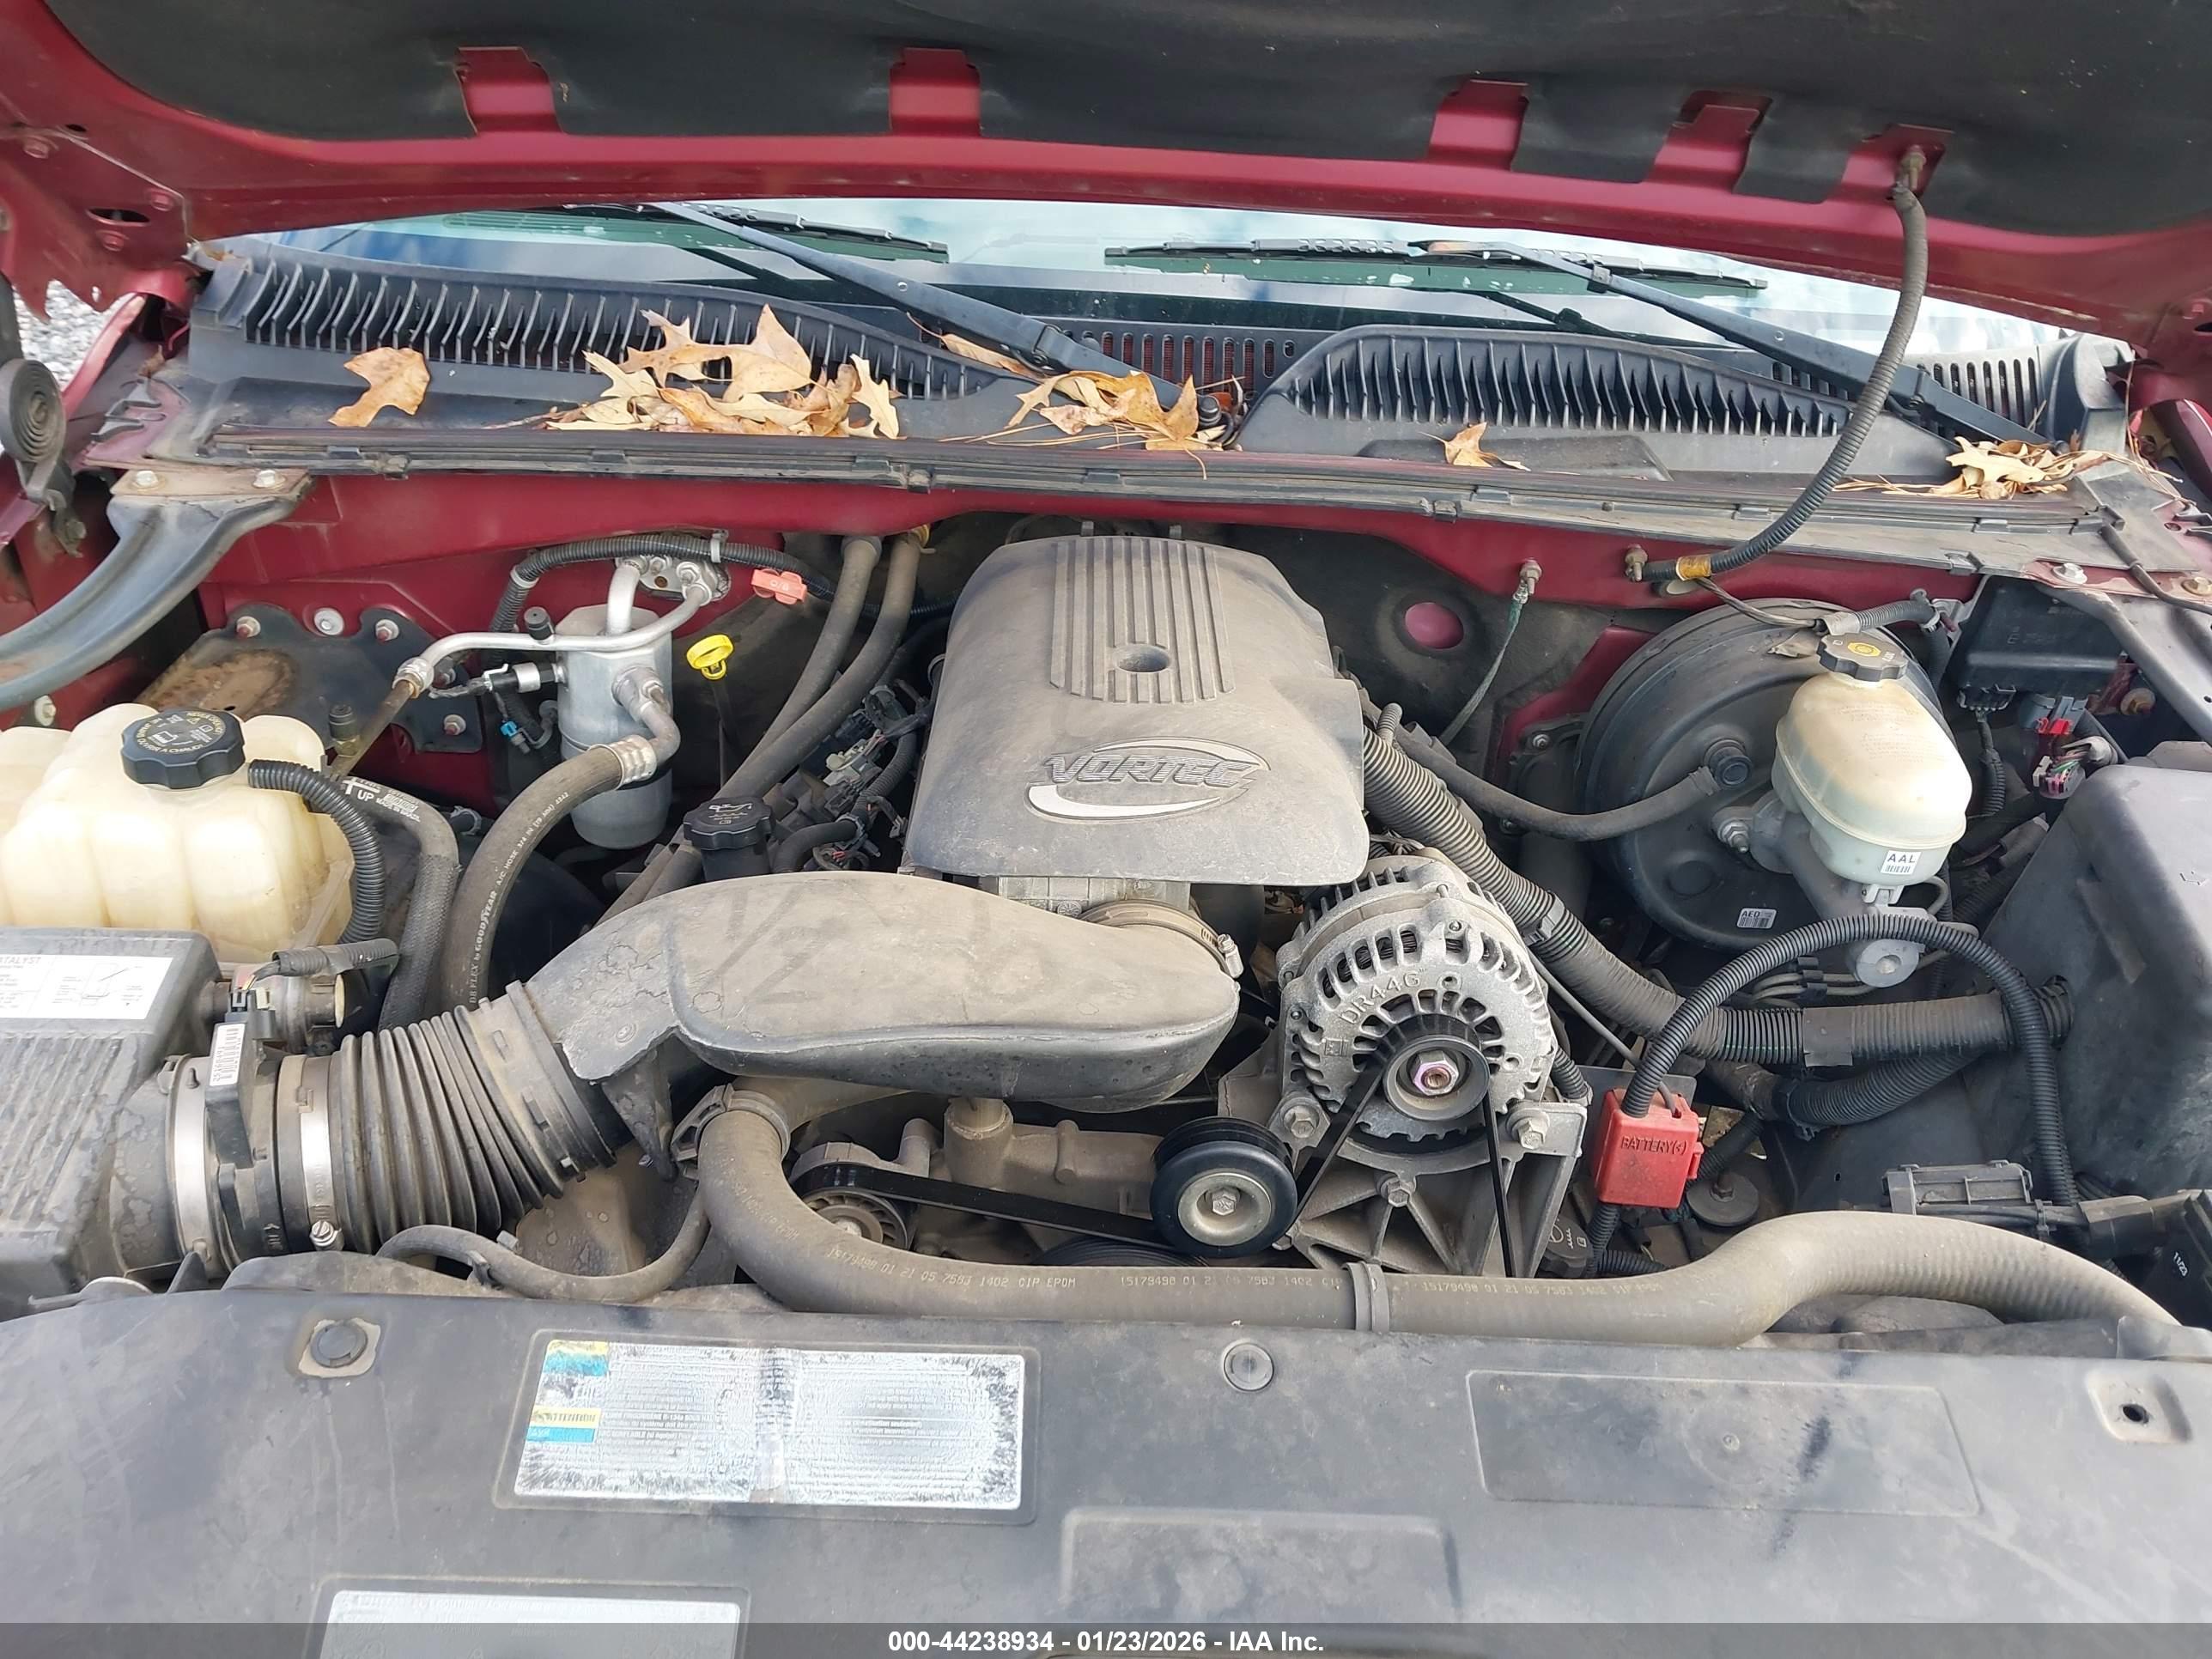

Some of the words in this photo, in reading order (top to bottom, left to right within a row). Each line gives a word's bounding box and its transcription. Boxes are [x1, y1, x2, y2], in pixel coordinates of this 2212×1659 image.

[1045, 754, 1253, 788] VORTEC
[357, 789, 374, 801] UP
[1887, 853, 1916, 864] AAL
[475, 890, 498, 952] GOODYEAR
[503, 849, 519, 870] HOSE
[1339, 970, 1422, 1025] DR44G
[880, 1263, 896, 1275] 01
[1182, 1275, 1196, 1286] 01
